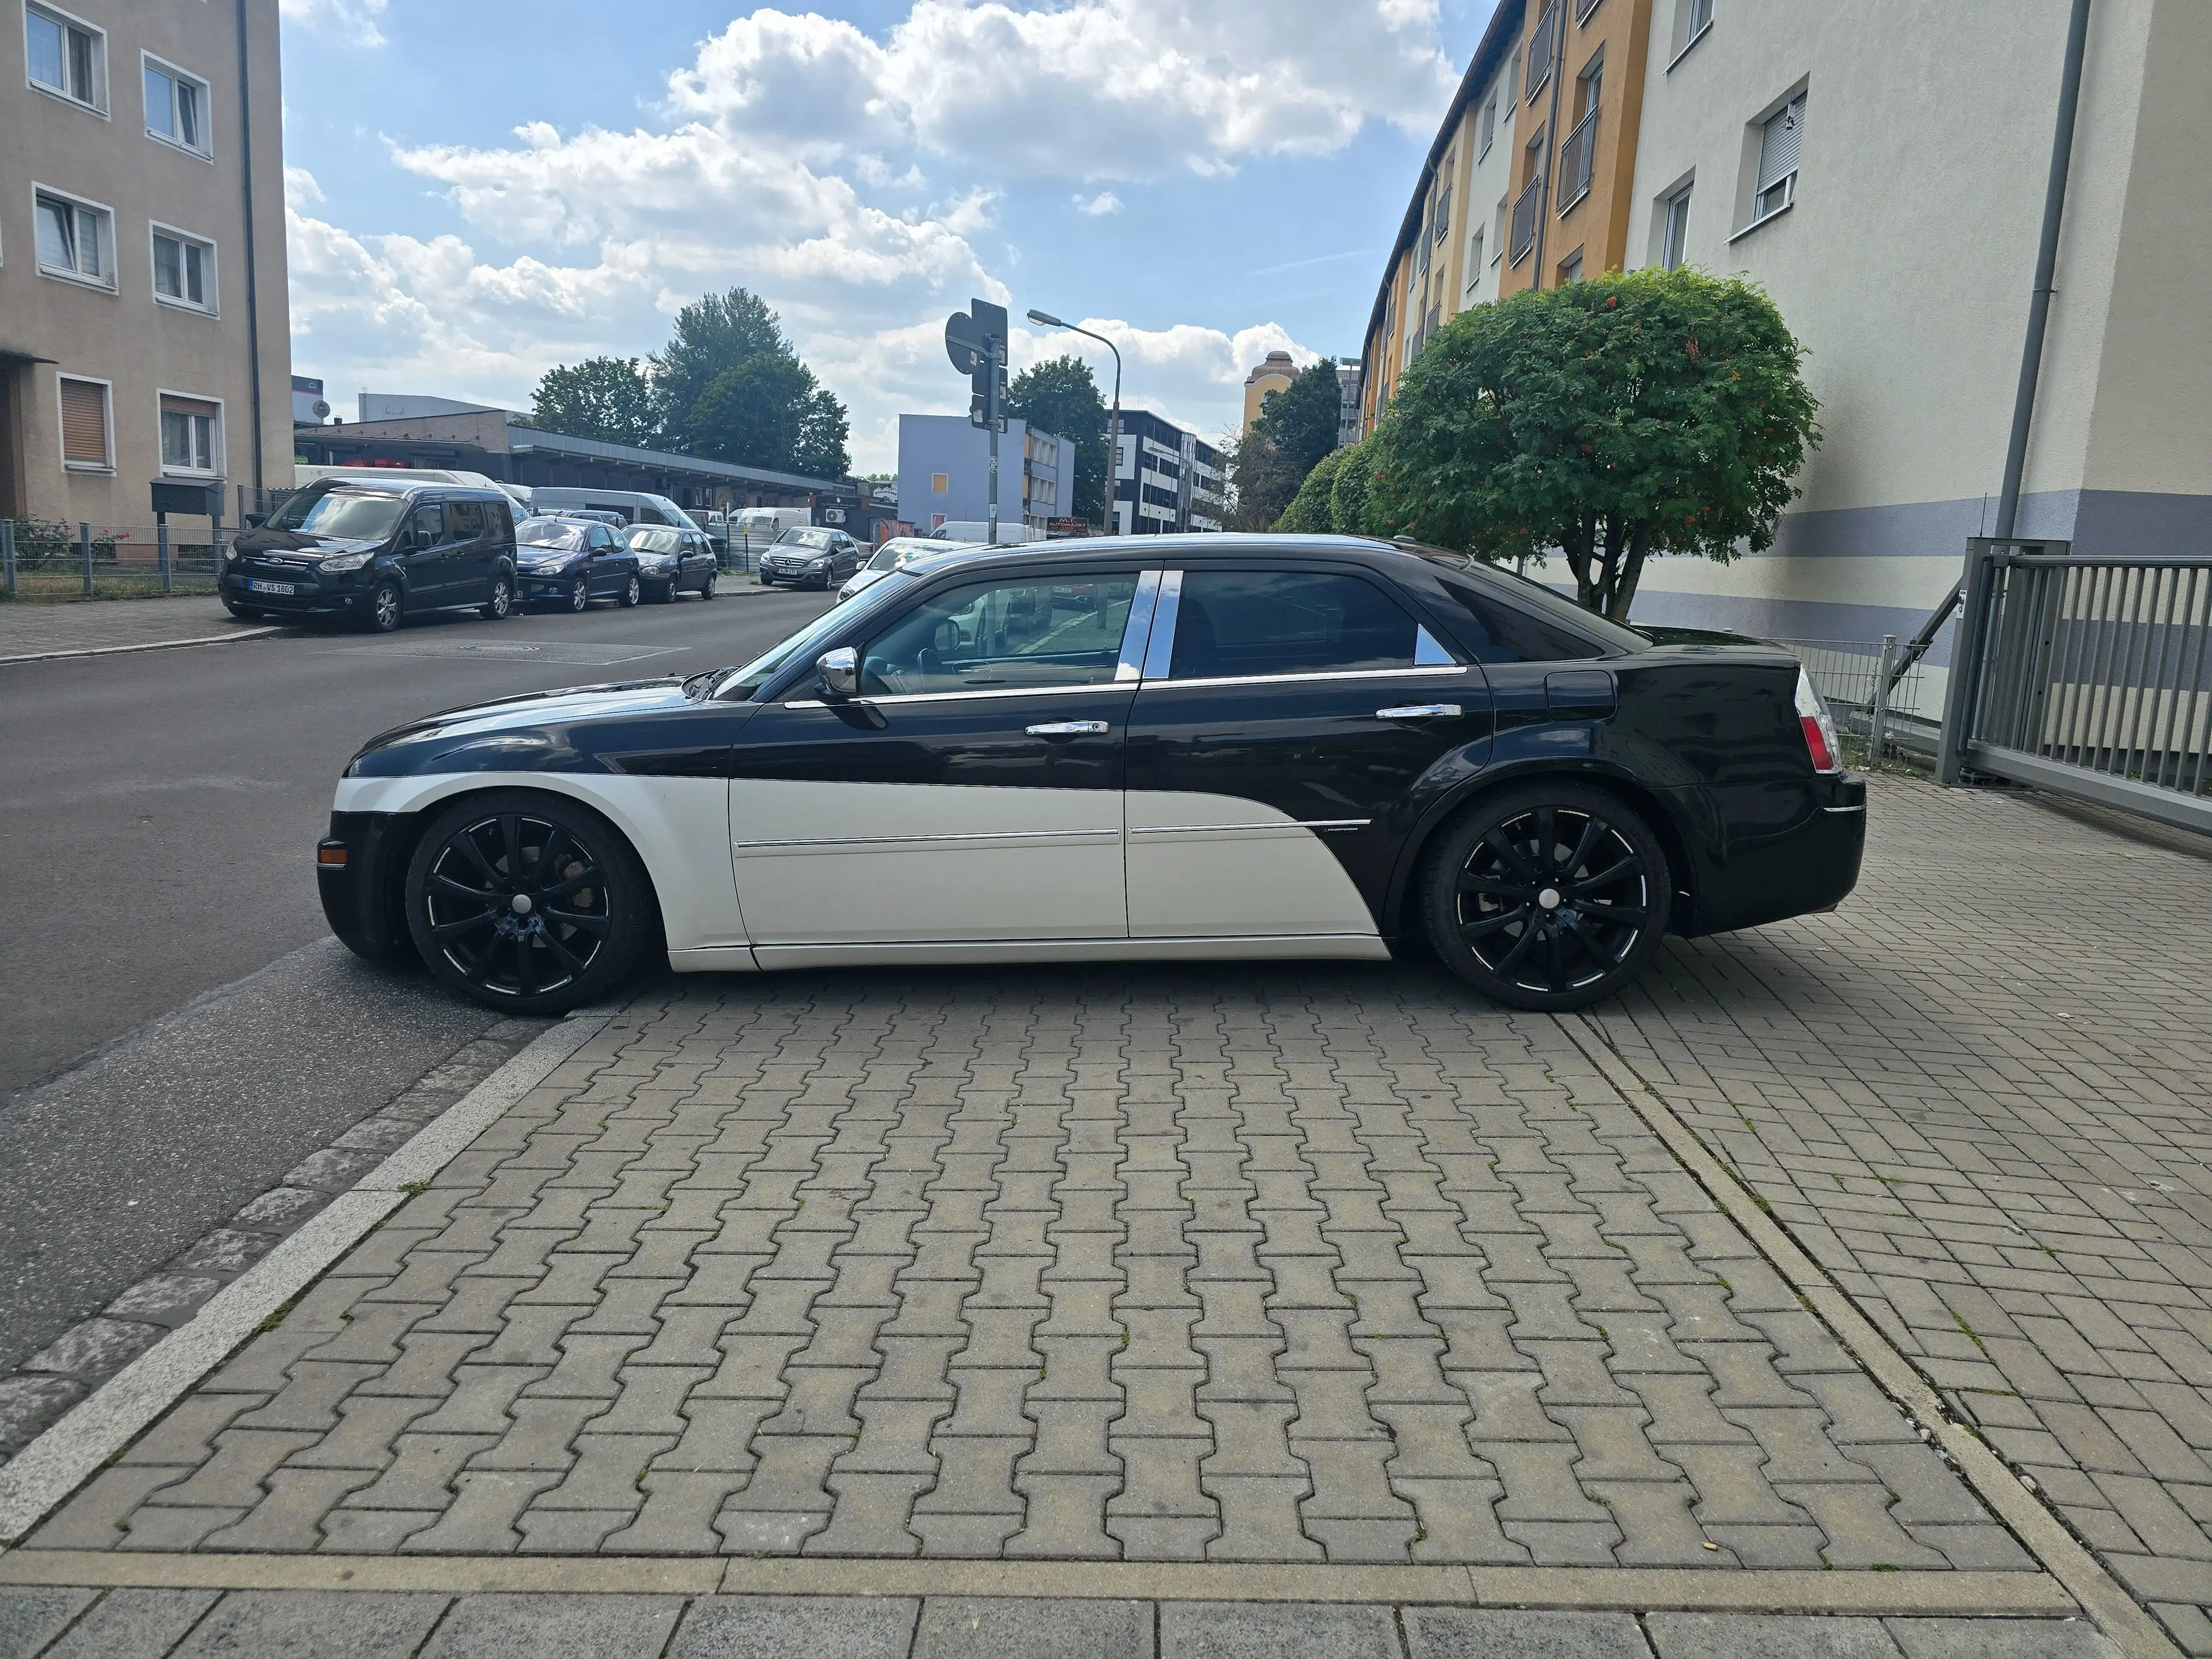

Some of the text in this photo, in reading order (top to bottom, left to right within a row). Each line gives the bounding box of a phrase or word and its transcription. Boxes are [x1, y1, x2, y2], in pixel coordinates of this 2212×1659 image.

[253, 582, 293, 594] RH VS 1802
